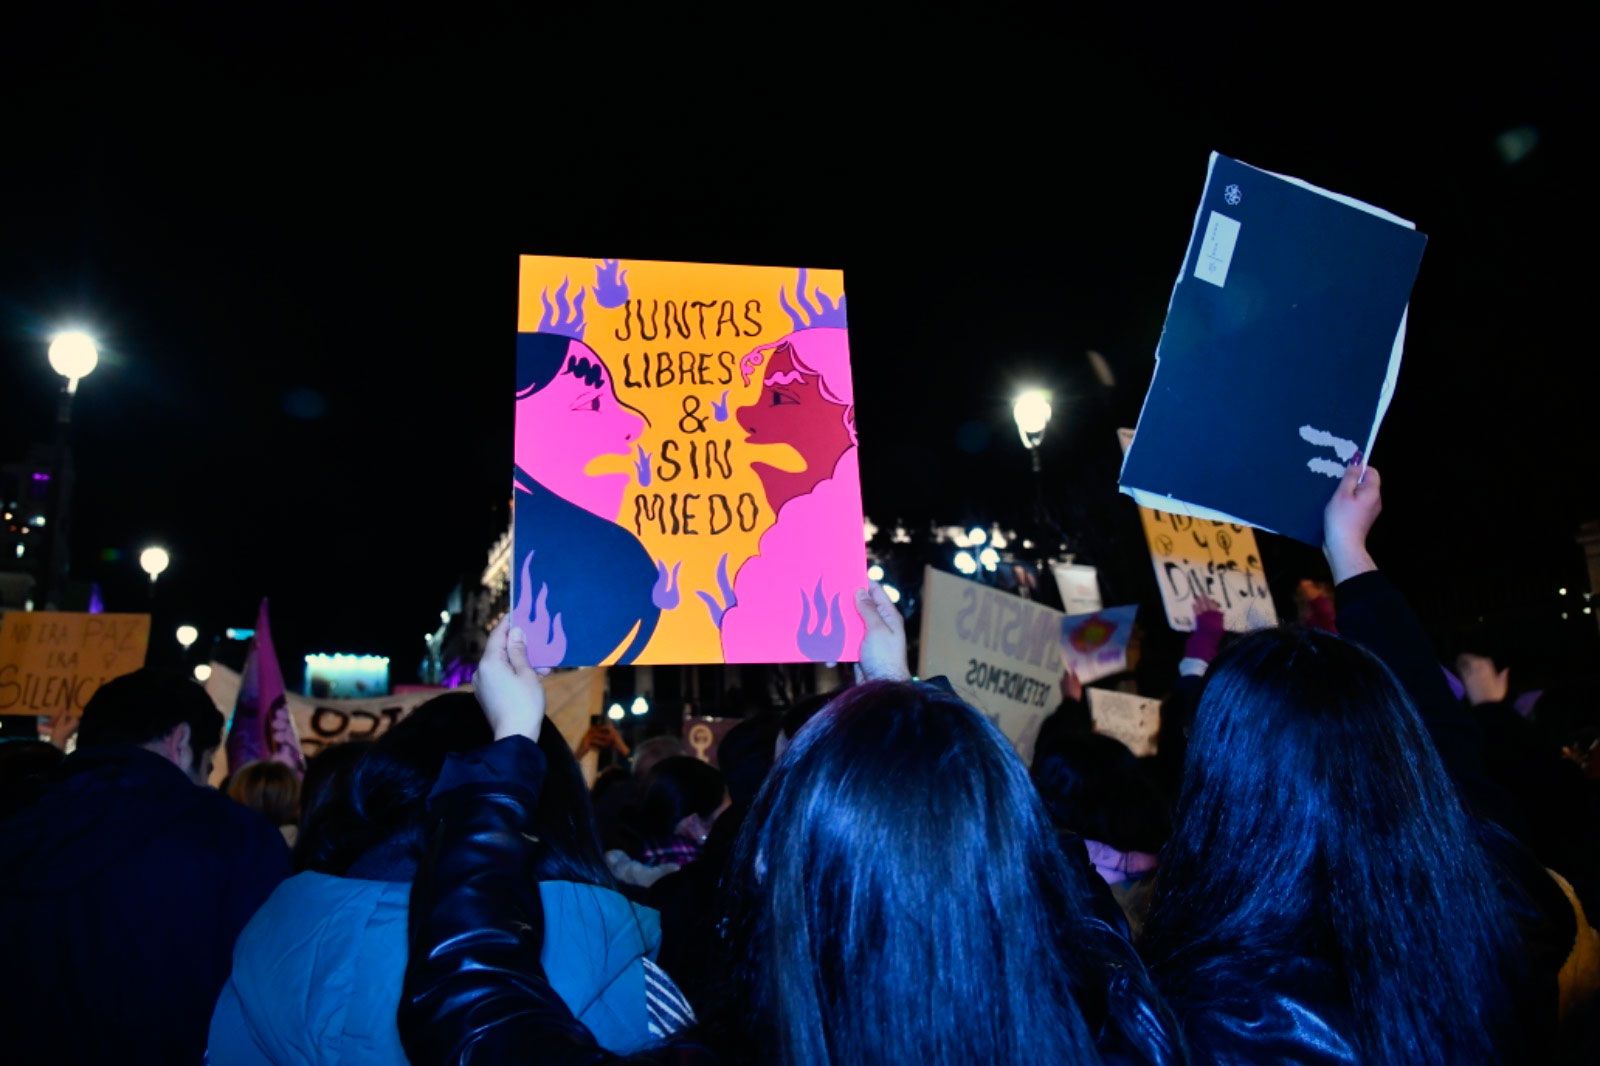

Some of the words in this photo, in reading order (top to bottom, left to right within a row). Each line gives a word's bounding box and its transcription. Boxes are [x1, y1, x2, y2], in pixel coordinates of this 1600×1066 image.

[615, 299, 762, 341] JUNTAS
[623, 351, 735, 388] LIBRES
[678, 395, 709, 434] &
[657, 439, 732, 482] SIN
[634, 492, 759, 536] MIEDO
[82, 618, 139, 651] PAZ
[0, 664, 105, 710] SILENC
